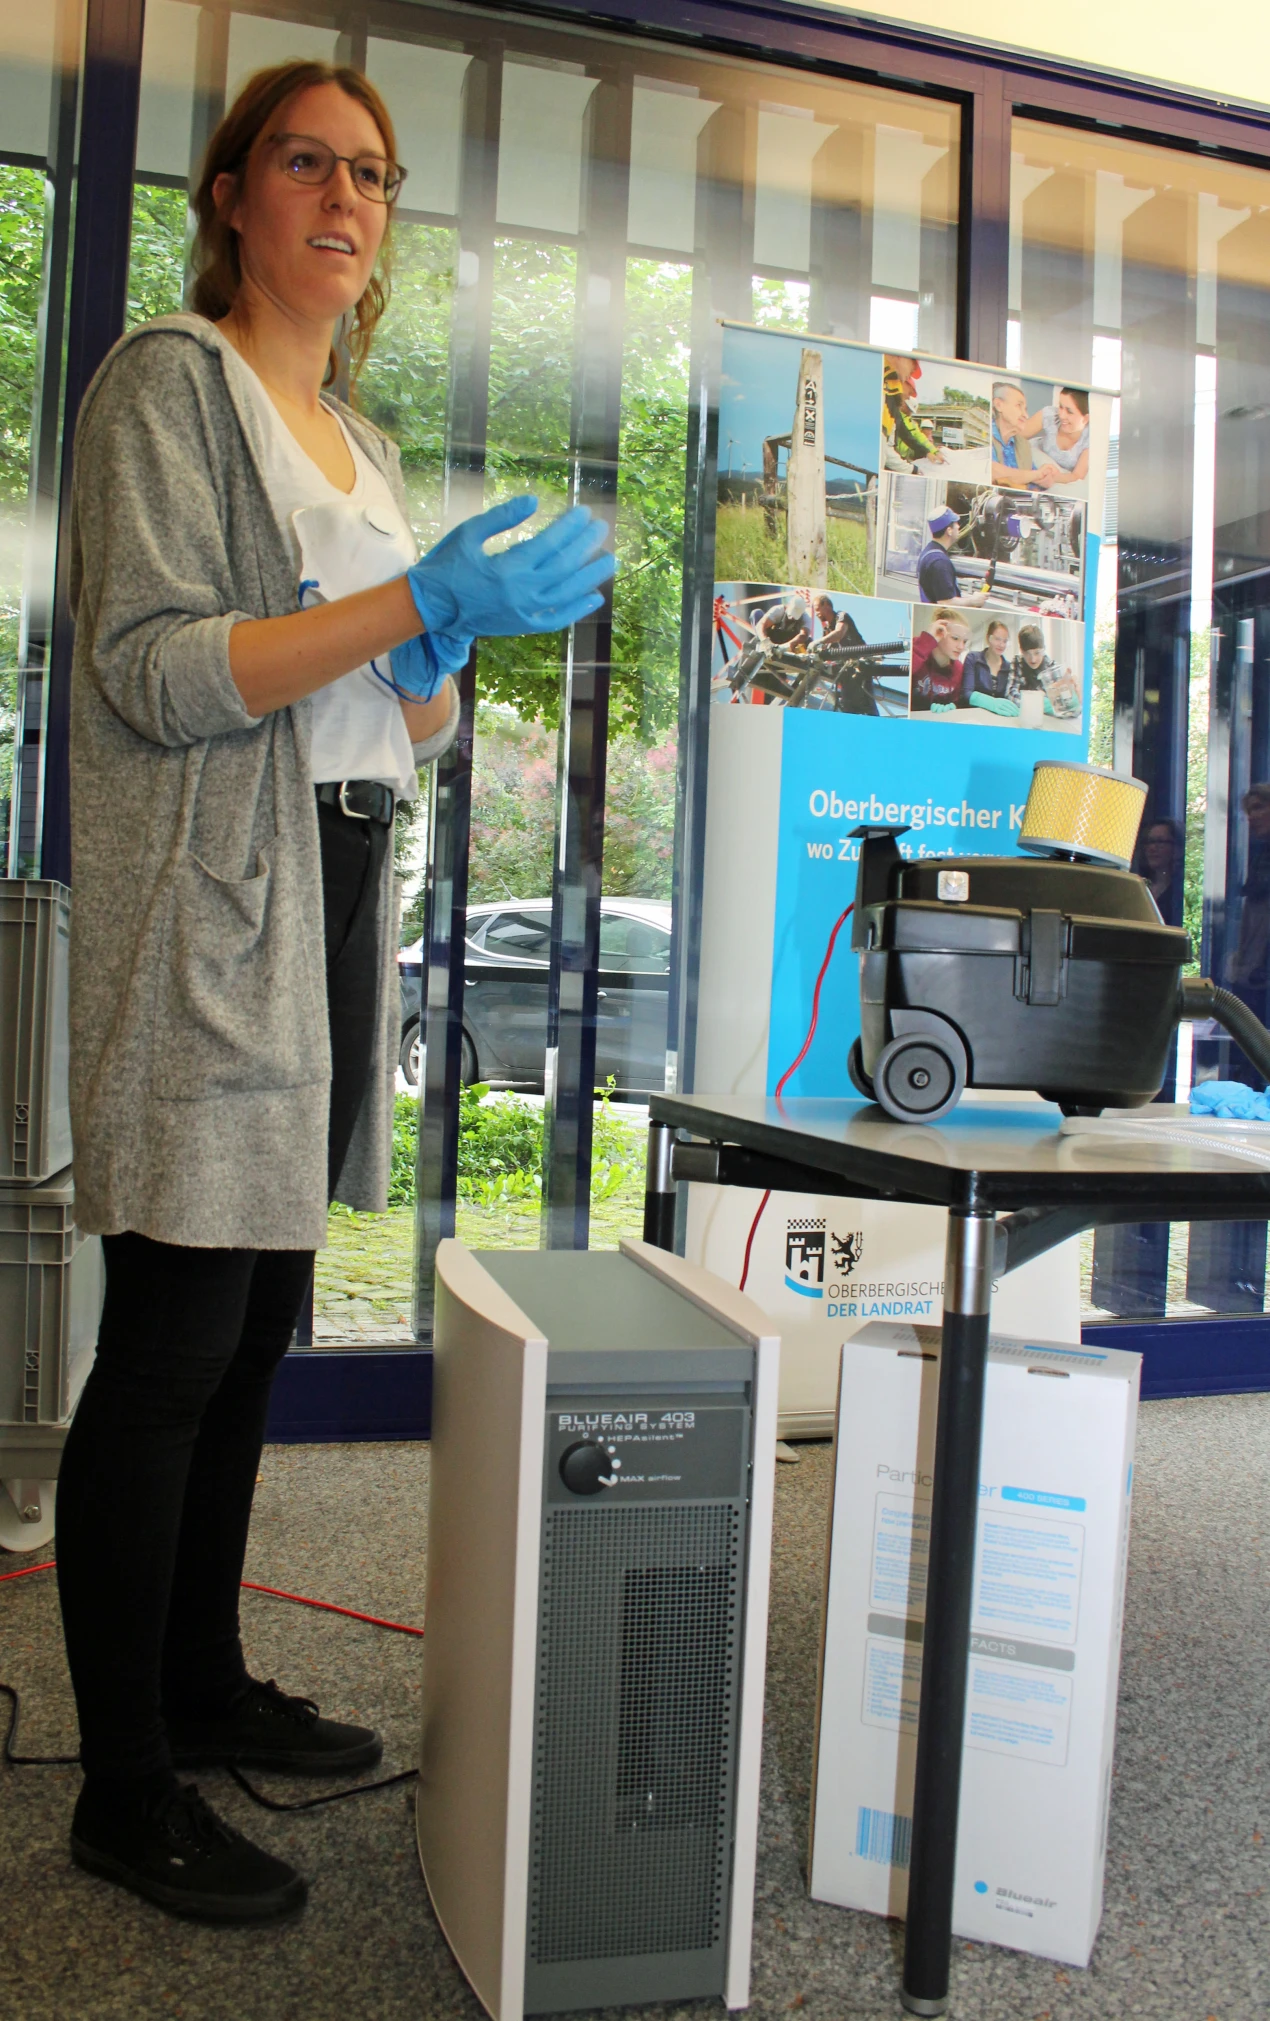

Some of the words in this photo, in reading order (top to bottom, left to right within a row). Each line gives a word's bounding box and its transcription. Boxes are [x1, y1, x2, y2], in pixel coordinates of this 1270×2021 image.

[809, 789, 1002, 831] Oberbergischer
[806, 842, 834, 860] wo
[837, 838, 913, 861] Zuft
[828, 1282, 945, 1299] OBERBERGISCHE
[827, 1302, 858, 1317] DER
[861, 1301, 933, 1317] LANDRAT
[558, 1414, 648, 1425] BLUEAIR
[660, 1412, 696, 1423] 403
[558, 1423, 633, 1432] PURIFYING
[640, 1422, 695, 1431] SYSTEM
[619, 1475, 645, 1483] MAX
[647, 1474, 682, 1482] airflow
[876, 1463, 933, 1487] Partic
[1016, 1490, 1036, 1501] 400
[1036, 1493, 1071, 1507] SERIES
[970, 1637, 1017, 1657] FACTS
[995, 1886, 1058, 1908] Blueair
